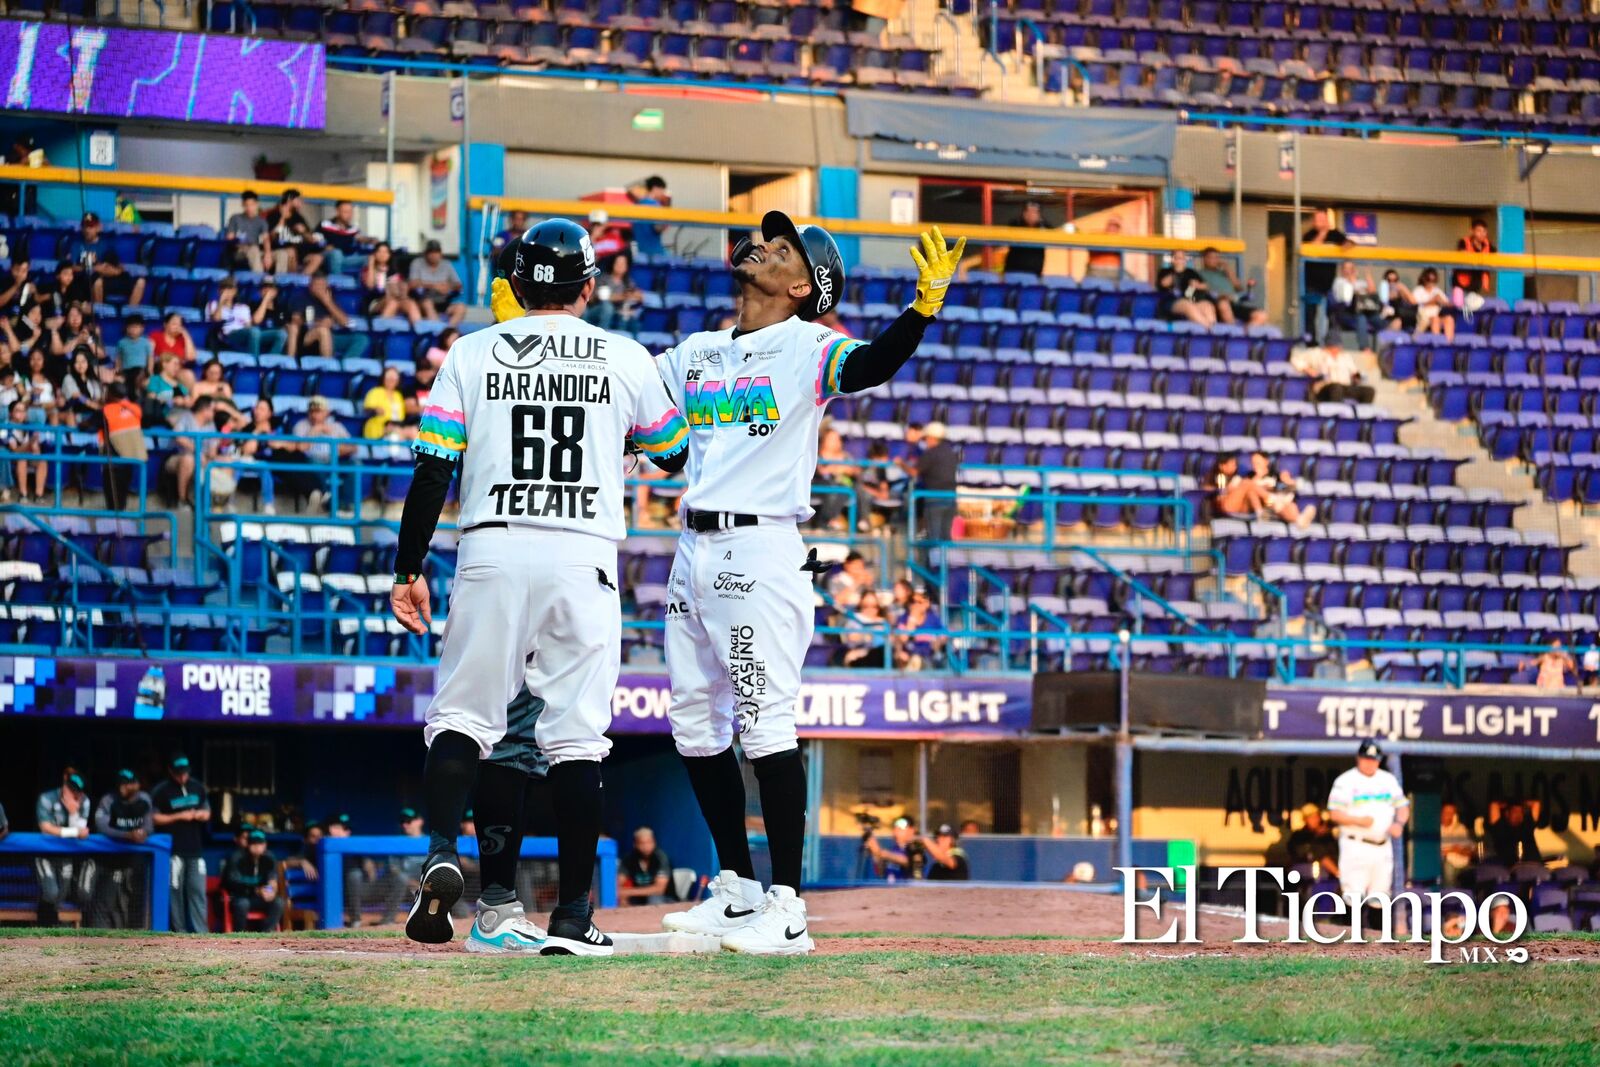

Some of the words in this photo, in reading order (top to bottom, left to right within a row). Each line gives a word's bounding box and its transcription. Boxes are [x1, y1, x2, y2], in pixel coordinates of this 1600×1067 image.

[533, 263, 555, 283] 68
[498, 332, 608, 362] VALUE
[486, 372, 611, 404] BARANDICA
[686, 369, 703, 381] DE
[511, 405, 585, 483] 68
[487, 483, 600, 519] TECATE
[713, 571, 757, 593] Ford
[718, 593, 745, 601] MONCLOVA
[729, 625, 739, 660] EAGLE
[182, 664, 271, 691] POWER
[740, 625, 754, 698] CASINO
[756, 659, 766, 695] HOTEL
[221, 690, 272, 716] ADE
[613, 687, 671, 719] POW
[796, 683, 870, 726] CATE
[884, 689, 1006, 724] LIGHT
[1318, 696, 1428, 739] TECATE
[1442, 705, 1558, 737] LIGHT
